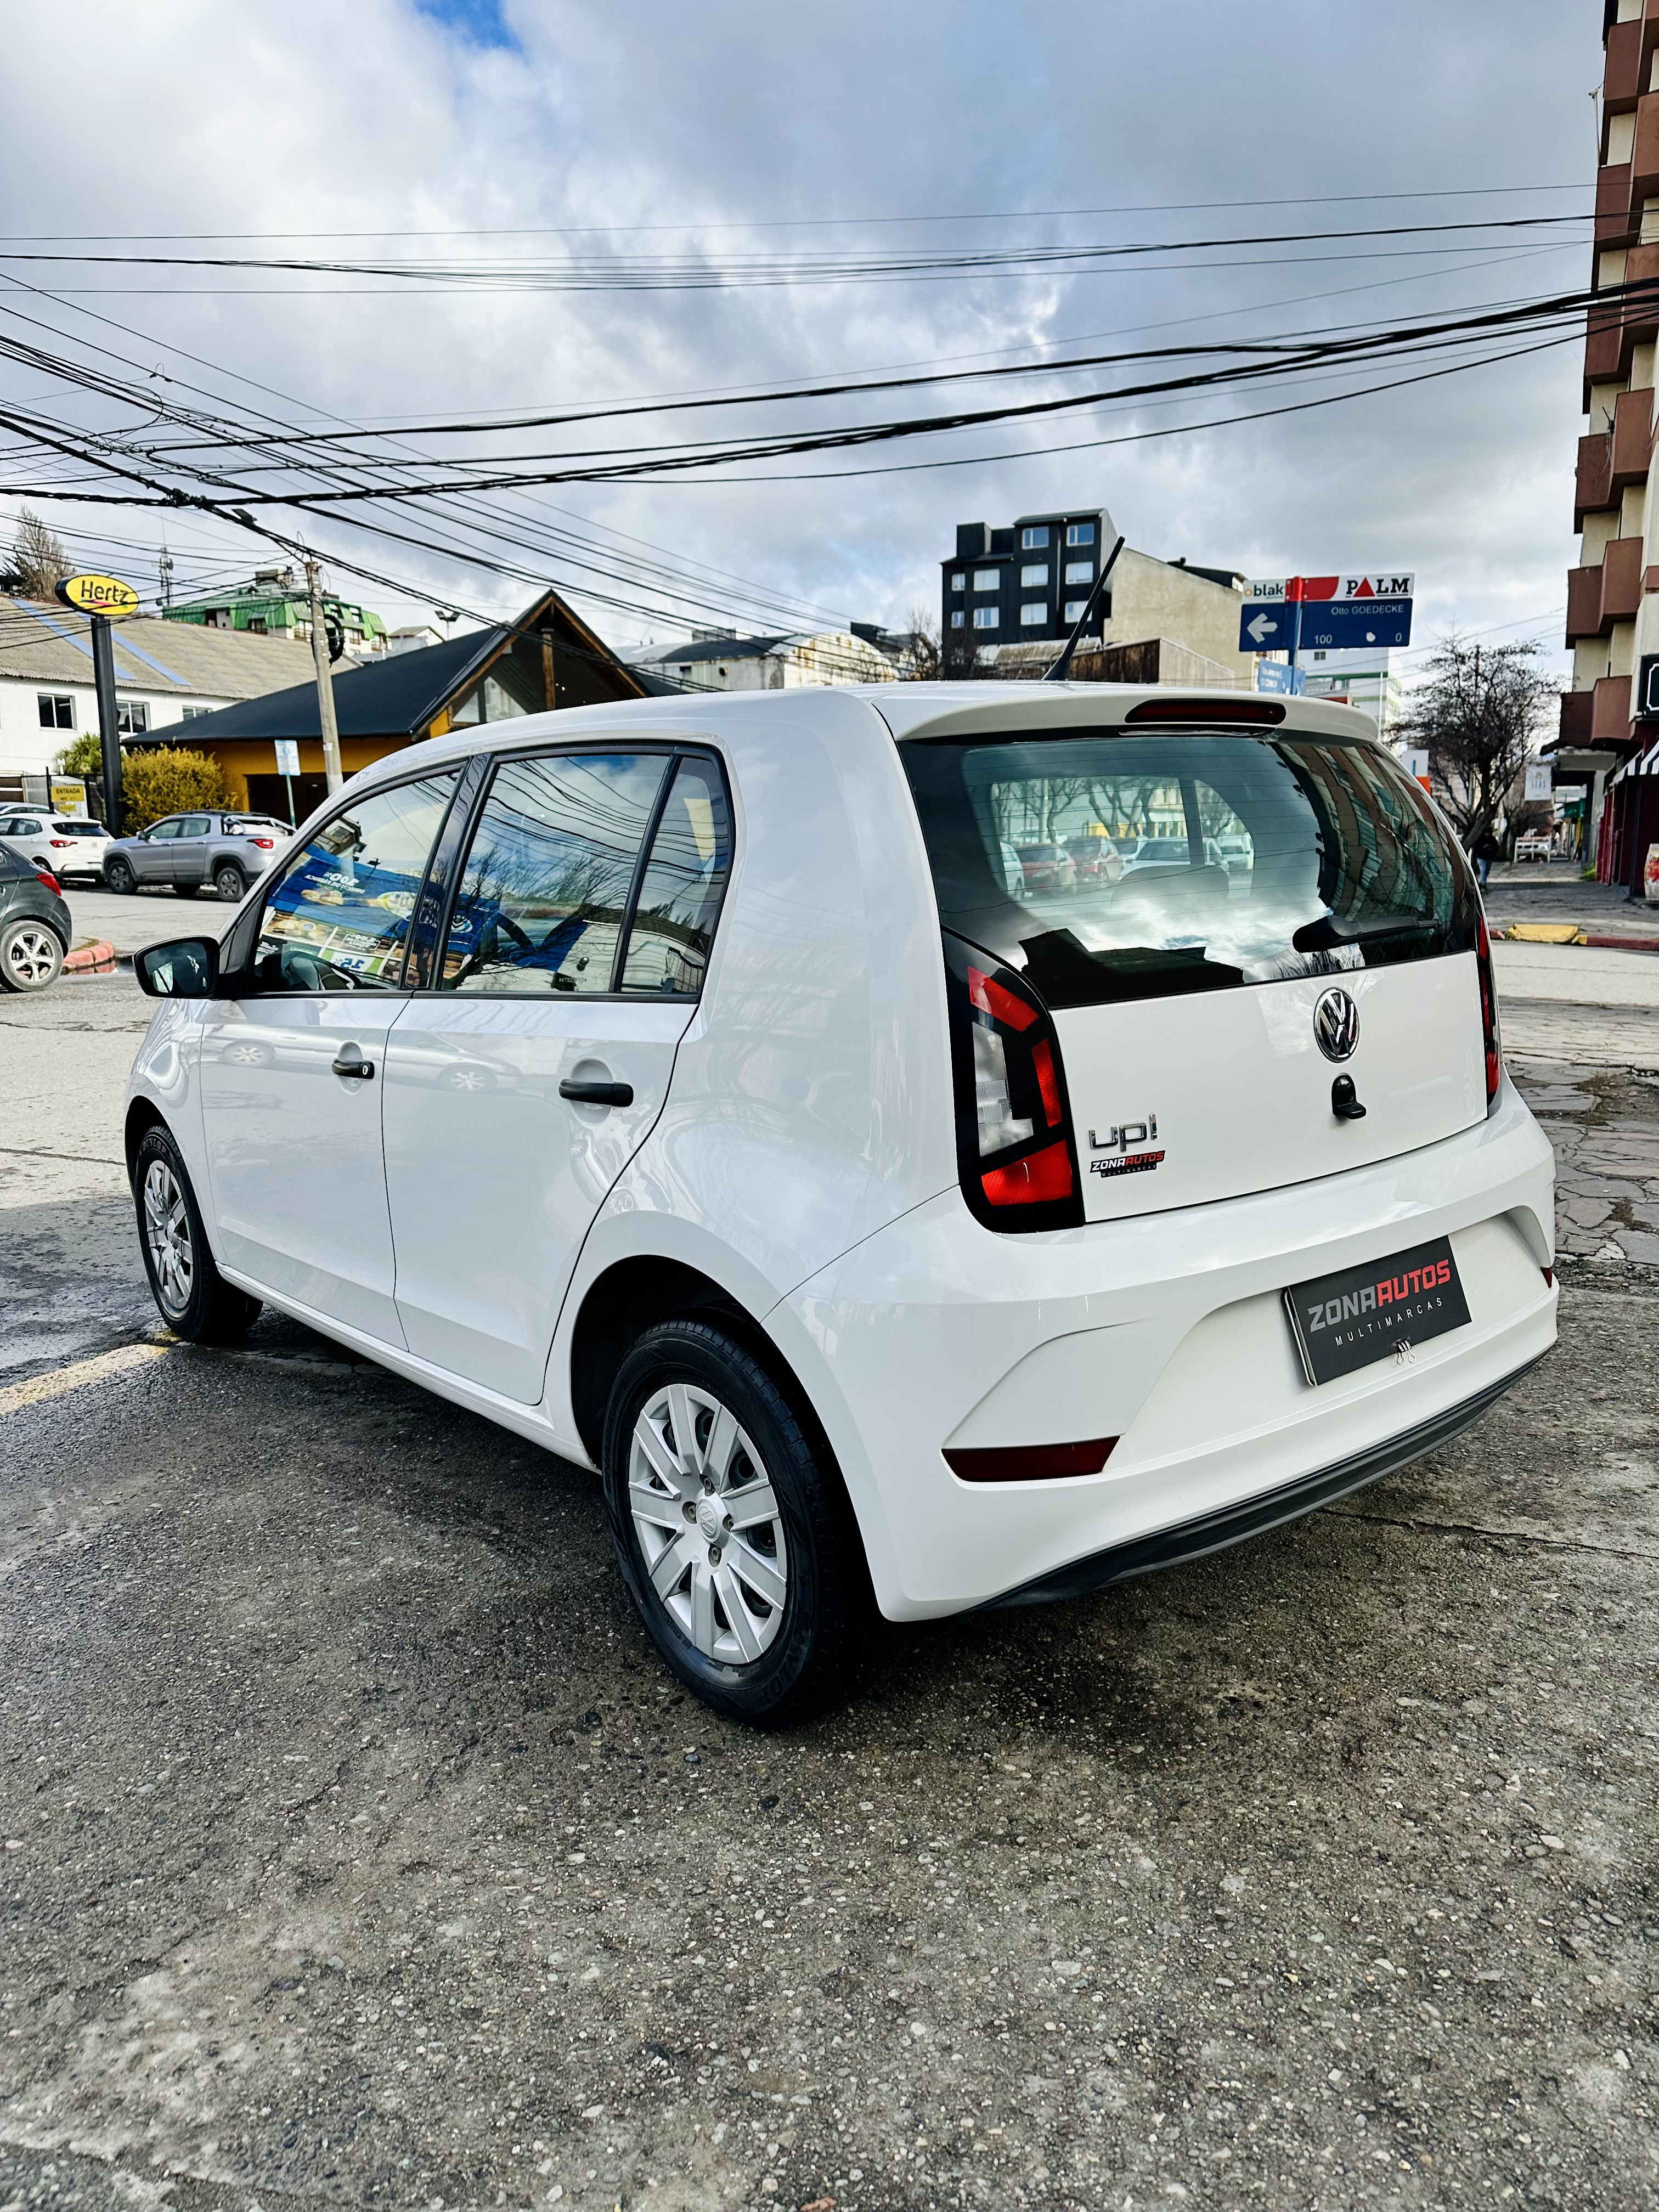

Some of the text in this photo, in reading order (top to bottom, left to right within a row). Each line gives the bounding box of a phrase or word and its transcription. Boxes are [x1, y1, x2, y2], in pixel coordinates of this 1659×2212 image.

[81, 580, 128, 603] Hertz
[1244, 583, 1284, 597] oblak
[1346, 577, 1410, 597] PALM
[1331, 604, 1404, 616] Otto GOEDECKE
[1314, 632, 1402, 644] 100 0
[1089, 1112, 1158, 1153] up!
[1102, 1164, 1156, 1177] MULTIMARCAS
[1335, 1297, 1443, 1347] MULTIMARCAS
